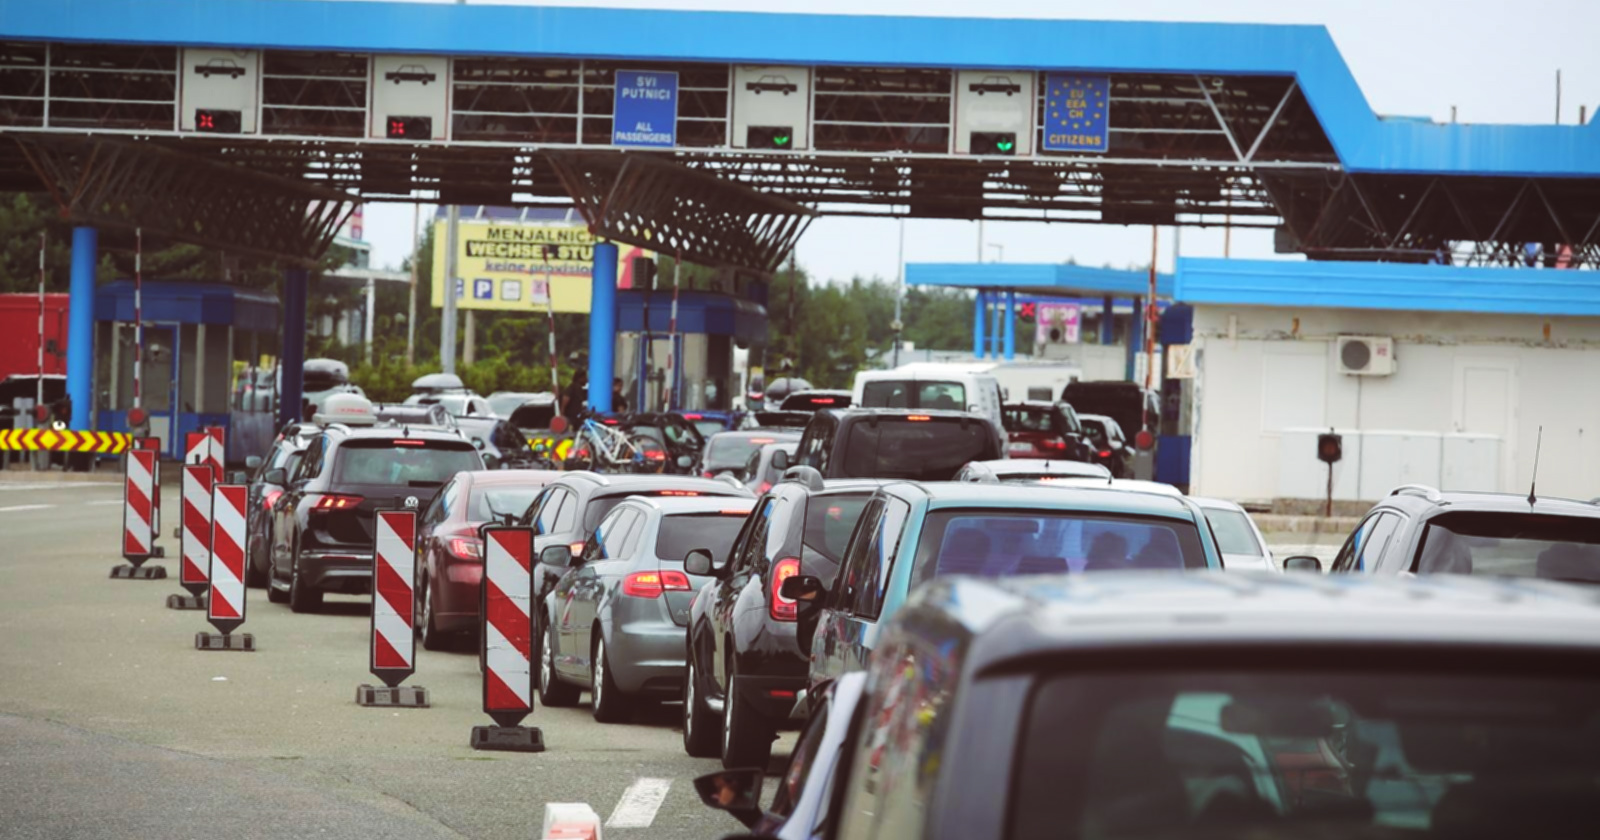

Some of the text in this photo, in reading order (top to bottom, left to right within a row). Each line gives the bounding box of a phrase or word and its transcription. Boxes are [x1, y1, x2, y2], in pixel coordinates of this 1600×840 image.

[636, 76, 657, 87] SVI
[622, 88, 671, 100] PUTNICI
[1070, 89, 1084, 98] EU
[1066, 99, 1087, 108] EEA
[1069, 109, 1084, 118] CH
[635, 122, 653, 132] ALL
[615, 131, 672, 143] PASSENGERS
[1049, 134, 1102, 146] CITIZENS
[485, 258, 526, 272] keine
